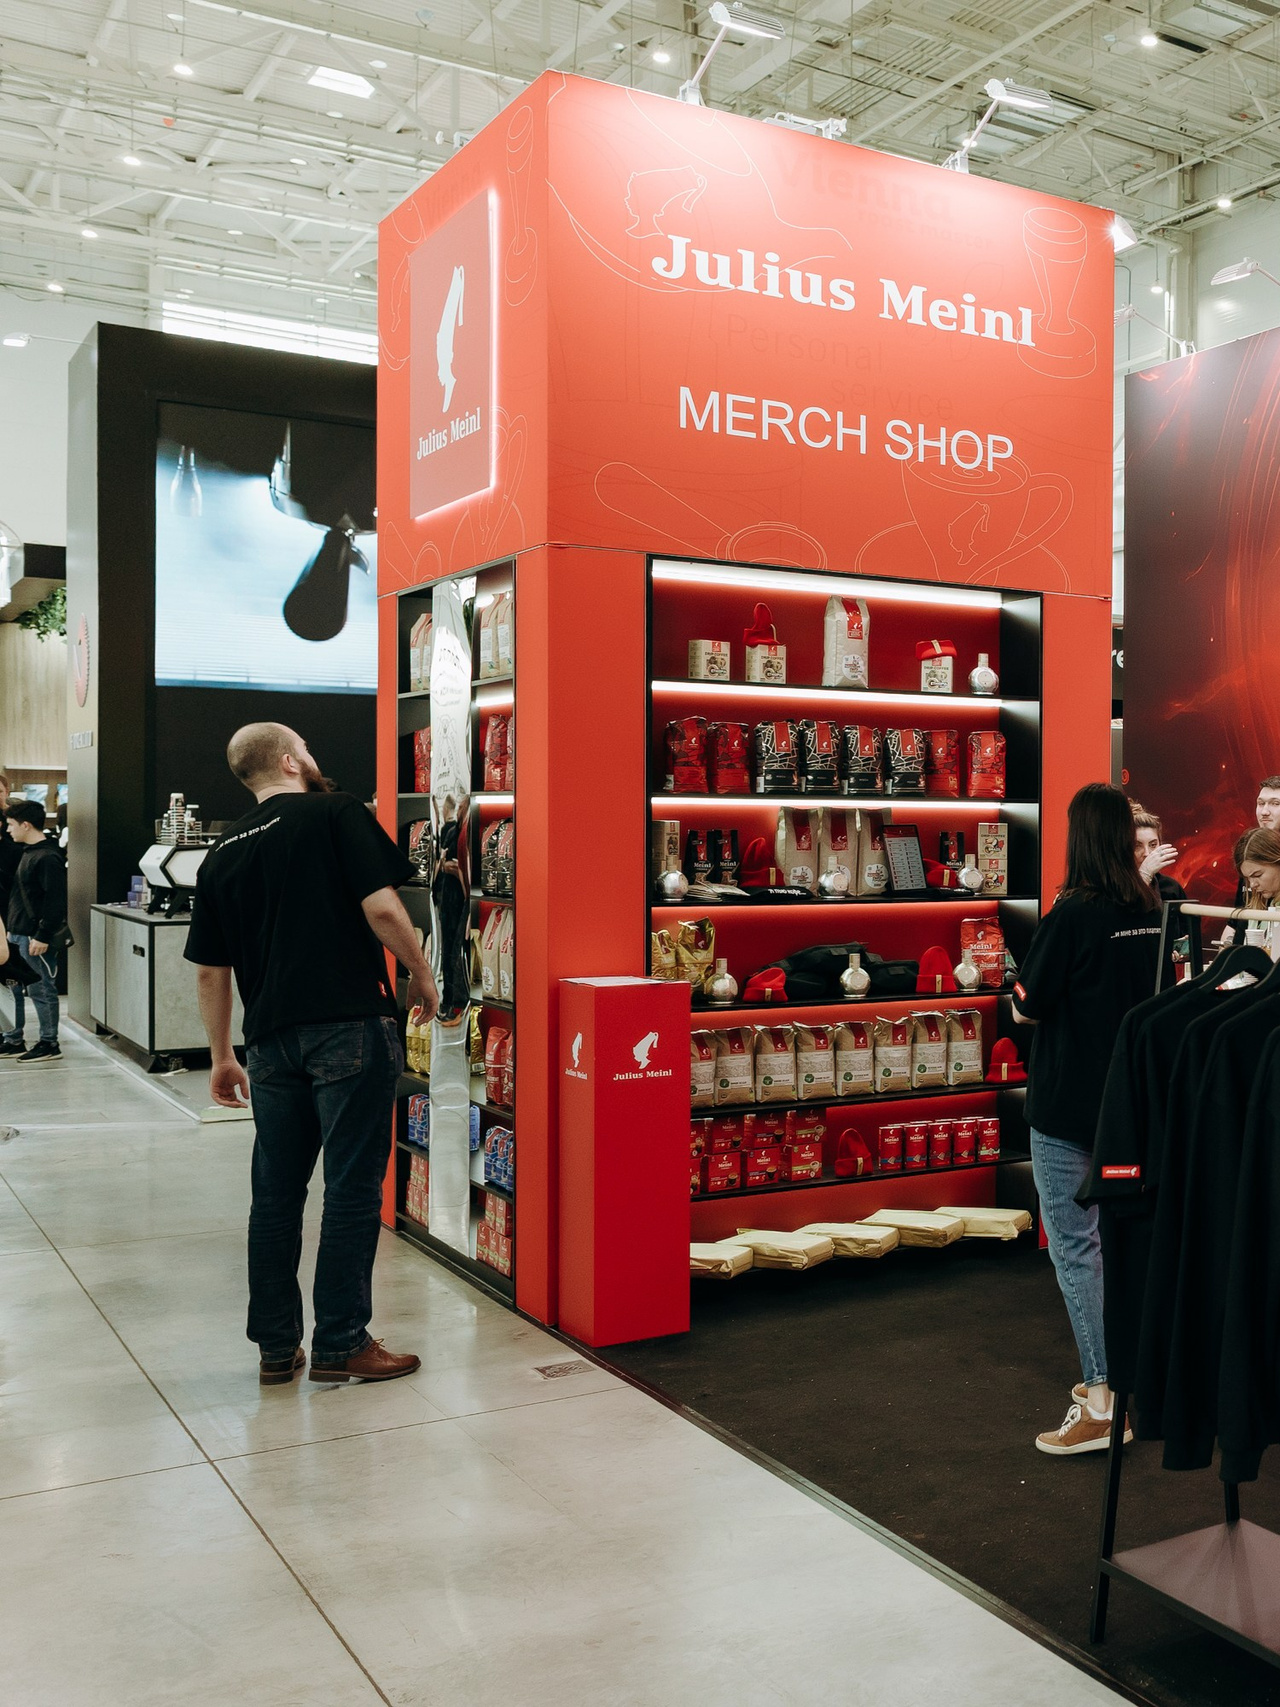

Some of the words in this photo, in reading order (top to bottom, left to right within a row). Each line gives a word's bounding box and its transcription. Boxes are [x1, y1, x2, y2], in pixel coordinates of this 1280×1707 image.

[651, 234, 856, 312] Julius
[879, 279, 1036, 347] Meinl
[726, 312, 884, 373] Personal
[830, 376, 955, 420] service
[416, 428, 448, 460] Julius
[449, 407, 481, 443] Meinl
[679, 386, 867, 455] MERCH
[885, 419, 1014, 472] SHOP
[248, 827, 260, 836] это
[694, 861, 712, 869] Meinl
[719, 860, 737, 868] Meinl
[1120, 929, 1132, 937] мне
[613, 1072, 643, 1081] Julius
[646, 1069, 672, 1078] Meinl
